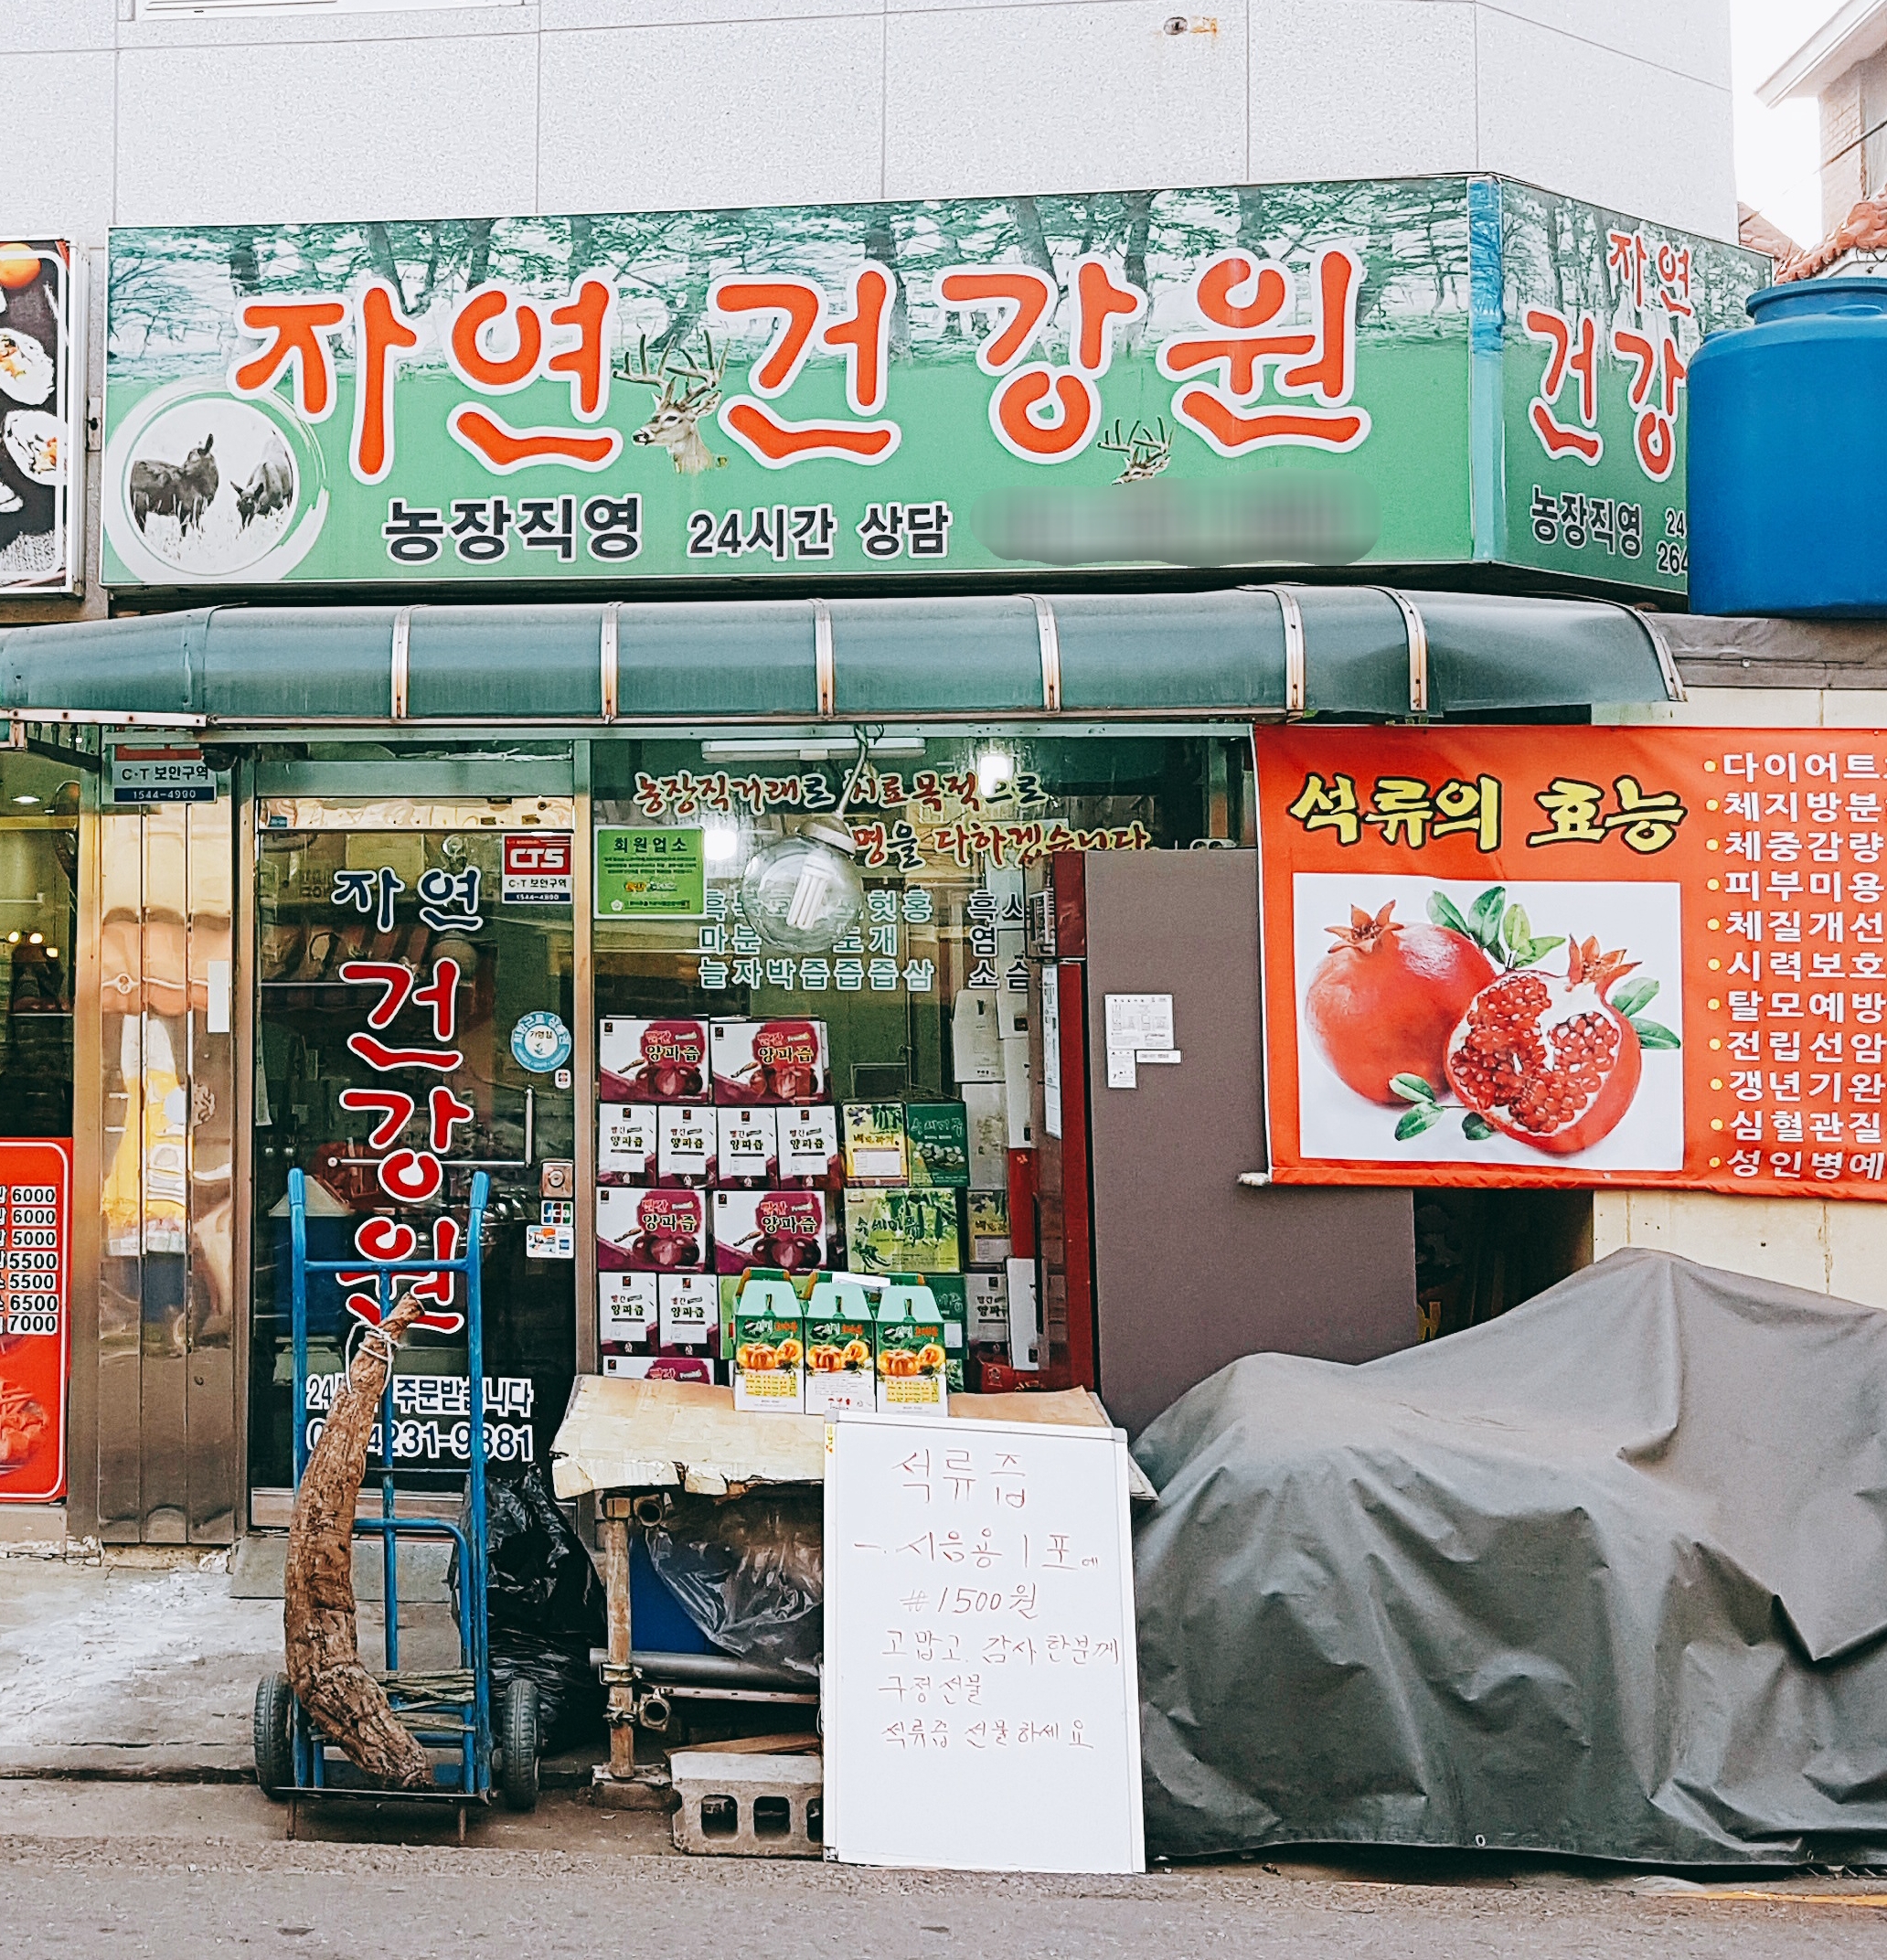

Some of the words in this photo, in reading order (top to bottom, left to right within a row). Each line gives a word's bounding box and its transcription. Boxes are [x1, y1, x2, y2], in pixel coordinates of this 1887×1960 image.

[1610, 233, 1691, 316] 자연
[232, 277, 616, 479] 자연
[712, 247, 1366, 463] 건강원
[1527, 310, 1688, 474] 건강
[384, 496, 642, 562] 농장직영
[689, 507, 835, 559] 24시간
[860, 505, 949, 558] 상담
[1531, 486, 1642, 557] 농장직영
[154, 766, 208, 781] 보안구역
[1723, 752, 1887, 783] 다이어트
[636, 771, 834, 815] 농장직거래로
[1724, 792, 1887, 823] 체지방분
[1289, 772, 1502, 851] 석류의
[1529, 775, 1689, 855] 효능
[510, 848, 565, 868] CTS
[613, 836, 688, 853] 회원업소
[1725, 830, 1884, 864] 체중감량
[332, 868, 484, 932] 자연
[1725, 870, 1885, 903] 피부미용
[1725, 911, 1885, 943] 체질개선
[1726, 951, 1887, 983] 시력보호
[1728, 990, 1887, 1025] 탈모예방
[645, 1045, 700, 1062] 양파즙
[759, 1046, 814, 1063] 양파즙
[1727, 1030, 1887, 1063] 전립선암
[1729, 1071, 1887, 1102] 갱년기완
[1730, 1110, 1883, 1143] 심혈관질
[1727, 1149, 1886, 1181] 성인병예
[12, 1188, 55, 1203] 6000
[13, 1209, 56, 1224] 6000
[643, 1214, 697, 1232] 양파즙
[762, 1216, 817, 1233] 양파즙
[12, 1230, 56, 1245] 5000
[9, 1253, 57, 1269] 5500
[10, 1273, 54, 1289] 5500
[10, 1294, 58, 1311] 6500
[8, 1315, 57, 1332] 7000
[890, 1448, 1028, 1509] 석류즙
[896, 1528, 1004, 1569] 시음용
[881, 1719, 949, 1750] 석류즙
